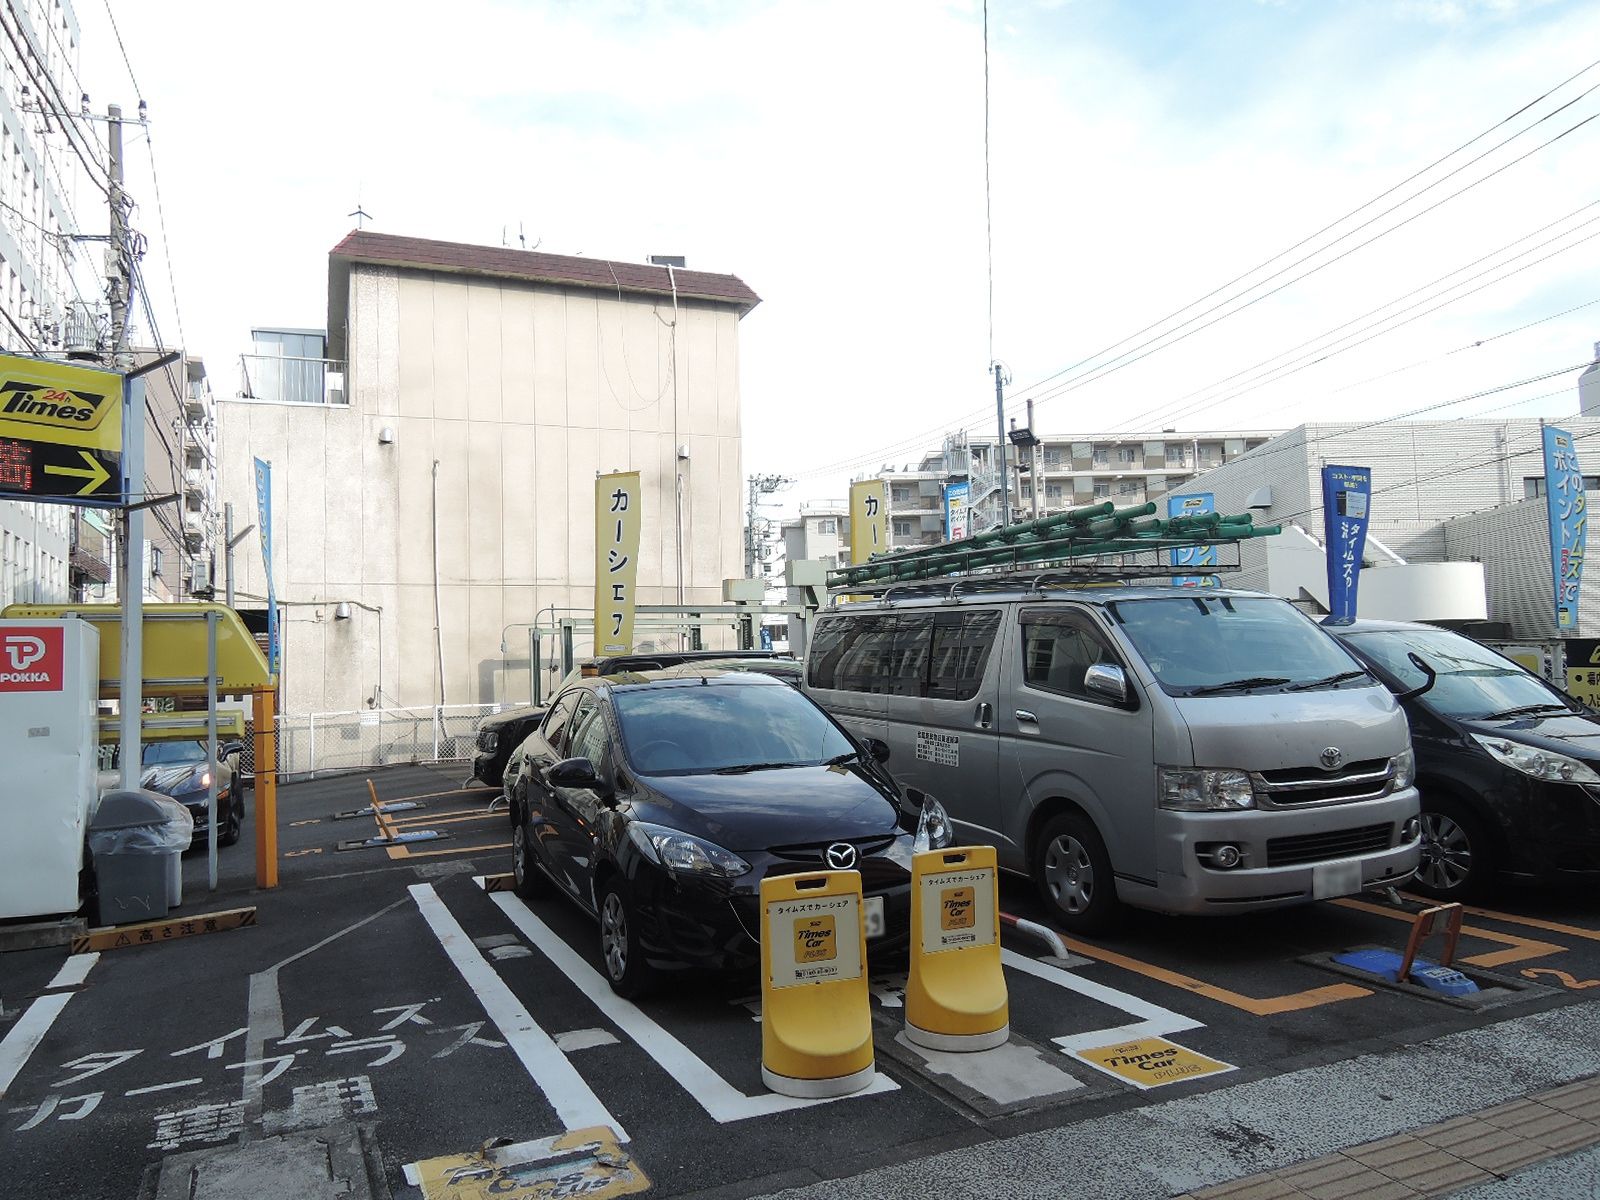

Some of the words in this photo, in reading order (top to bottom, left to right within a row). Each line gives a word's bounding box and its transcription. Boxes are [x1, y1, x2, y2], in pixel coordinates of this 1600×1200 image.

[43, 389, 71, 402] 24h
[1, 384, 94, 421] Times
[0, 672, 50, 683] POKKA
[778, 900, 849, 915] タイムズでカーシェア
[944, 900, 971, 909] Times
[950, 908, 966, 917] Car
[138, 919, 217, 943] 高さ注意
[798, 930, 832, 940] Times
[805, 938, 825, 948] Car
[51, 997, 441, 1088] タイムズ
[1104, 1048, 1178, 1067] Times
[1138, 1058, 1176, 1071] Car
[8, 1020, 508, 1131] カープラス
